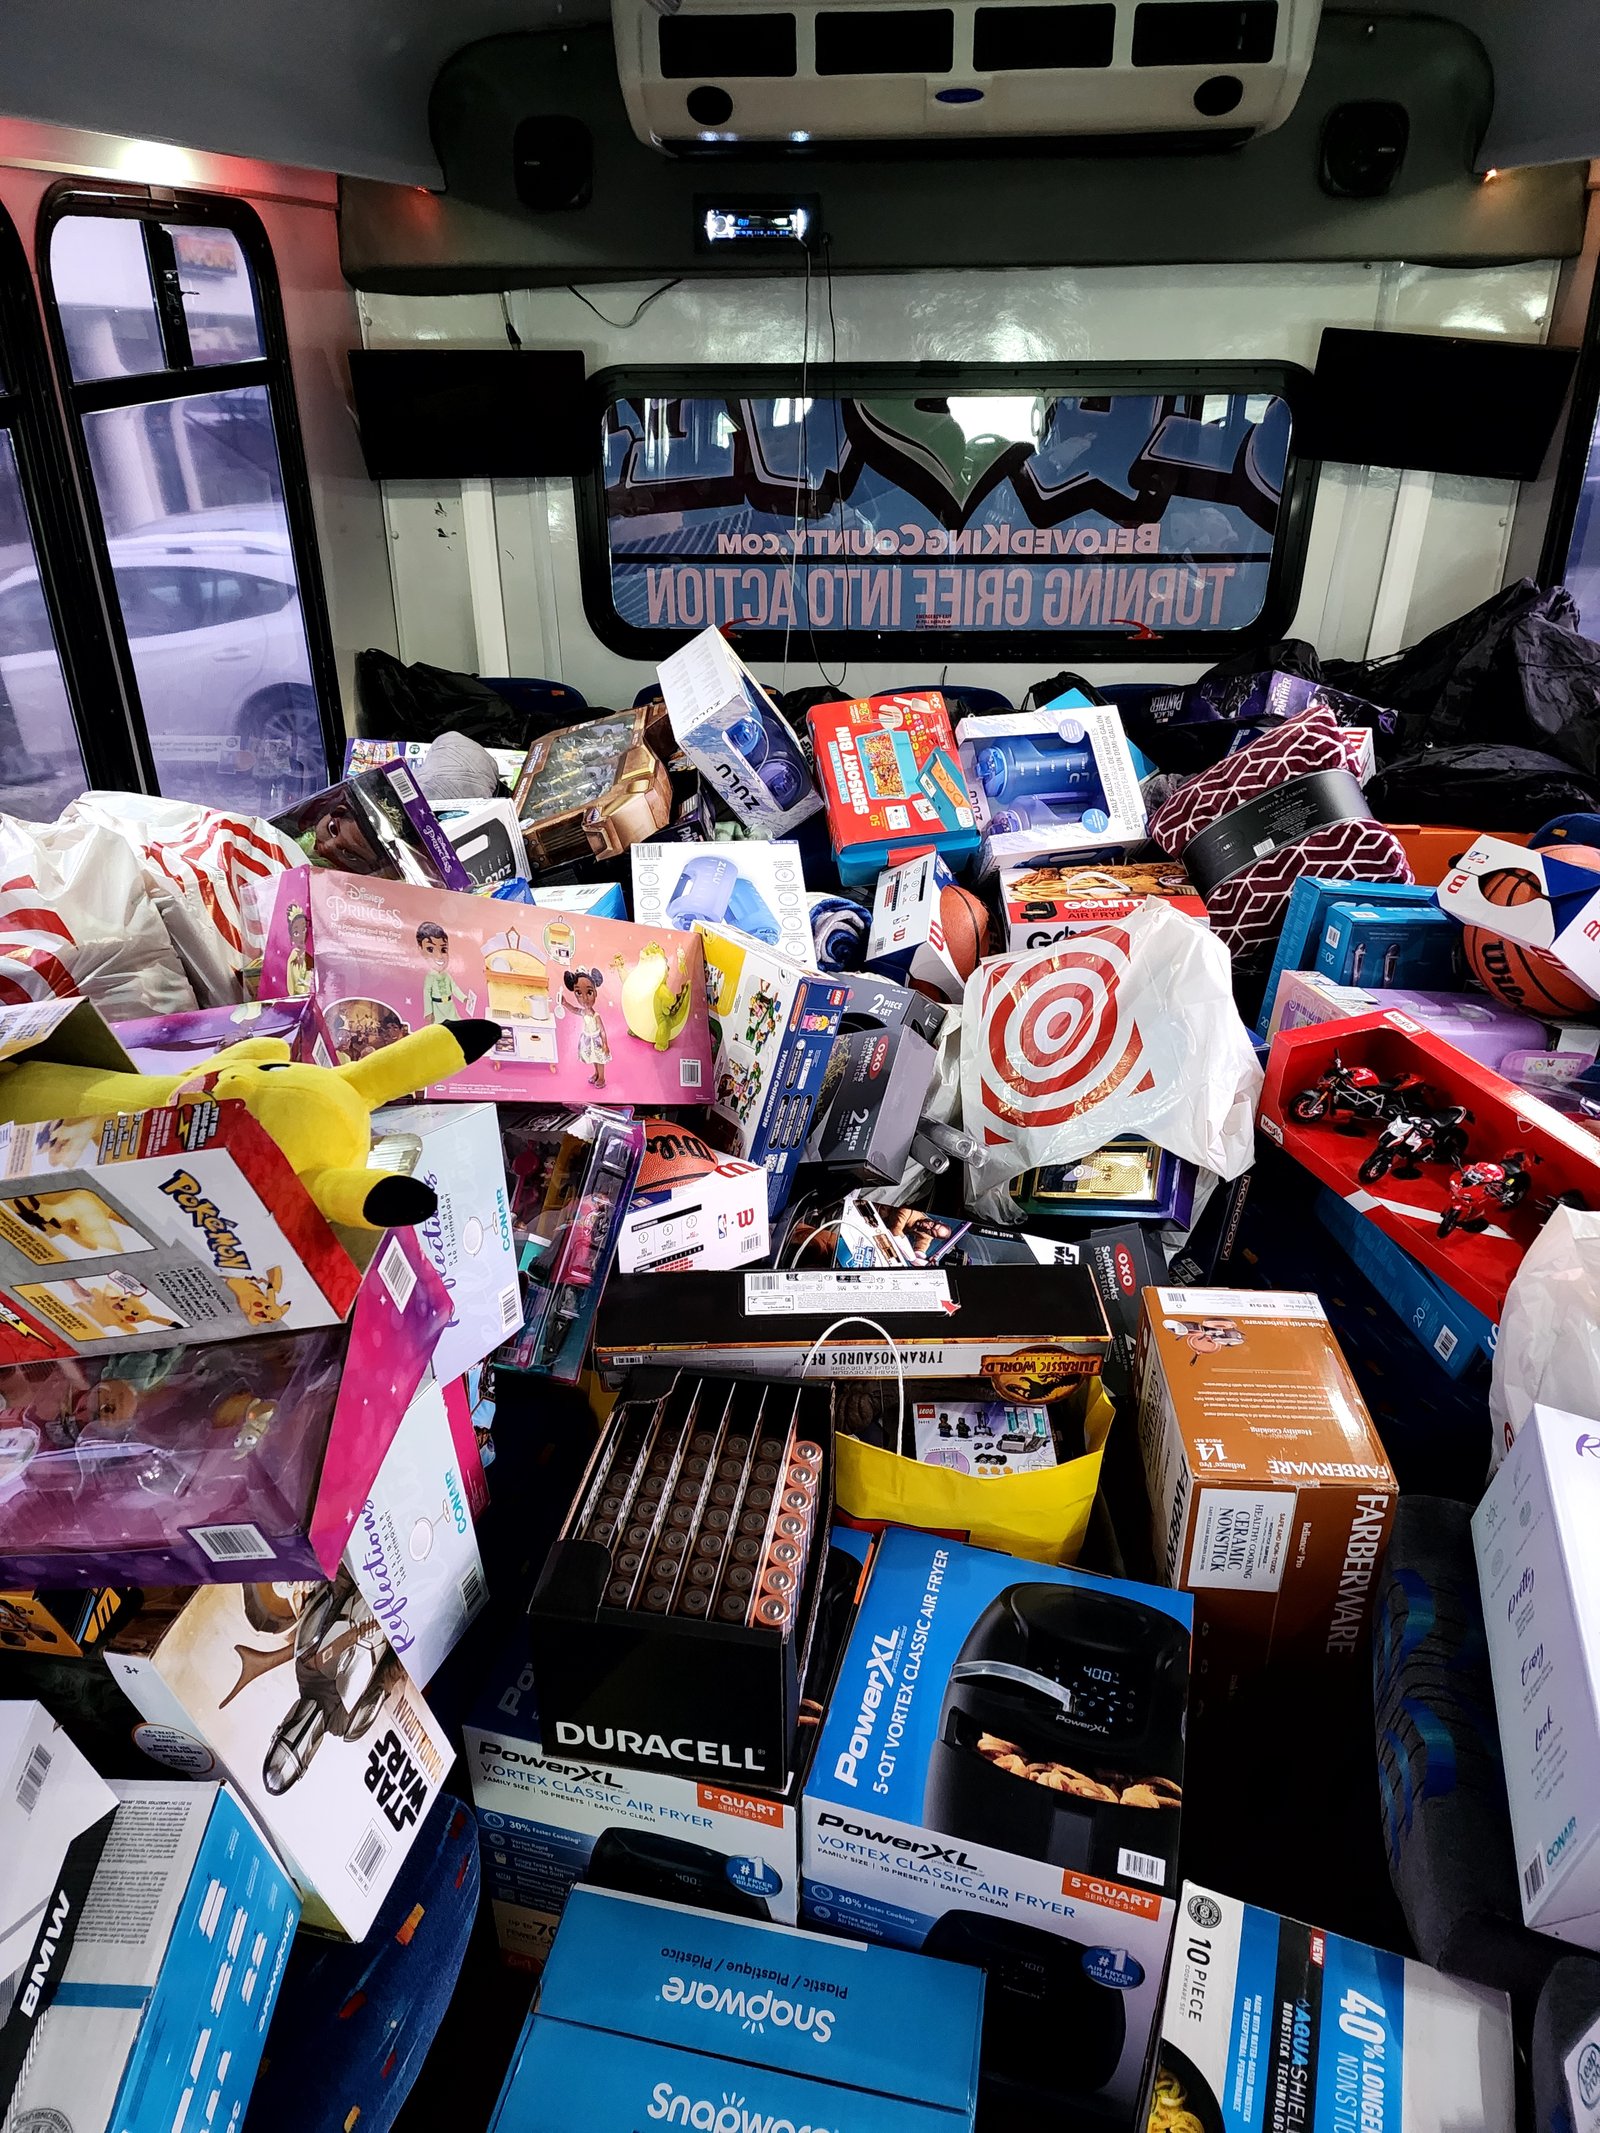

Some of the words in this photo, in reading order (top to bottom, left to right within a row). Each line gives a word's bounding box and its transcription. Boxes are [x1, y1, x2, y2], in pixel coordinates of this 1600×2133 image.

[1274, 677, 1292, 716] PANTHER
[835, 726, 854, 751] BIN
[1102, 736, 1113, 756] MEDIO
[1104, 715, 1120, 756] DEMI-GALLON
[713, 763, 761, 811] ZULU
[843, 753, 870, 815] SENSORY
[1103, 774, 1115, 797] GALLON
[870, 814, 881, 827] 50
[969, 790, 983, 822] ZULU
[1109, 798, 1120, 814] HALF
[423, 825, 453, 874] PRINCESS
[712, 860, 727, 886] ZULU
[326, 896, 402, 929] PRINCESS
[1063, 899, 1149, 910] Gourm
[1067, 911, 1089, 919] AIR
[868, 993, 885, 1014] 2
[883, 999, 903, 1010] PIECE
[880, 1008, 893, 1017] SET
[858, 1036, 877, 1083] SoftWorks
[871, 1042, 886, 1072] OXO
[762, 1082, 782, 1129] RECORRIDO
[777, 1049, 789, 1081] INICIAL
[849, 1108, 870, 1124] 2
[843, 1126, 855, 1142] SET
[848, 1126, 862, 1151] PIECE
[496, 1187, 511, 1252] CONAIR
[979, 1229, 999, 1237] WINDU
[1221, 1178, 1251, 1257] MONOPOLY
[1093, 1246, 1111, 1301] NON-STICK
[1101, 1245, 1120, 1300] SoftWorks
[1117, 1251, 1134, 1288] OXO
[211, 1287, 233, 1314] SOUNDS
[1410, 1304, 1429, 1328] 20
[831, 1350, 944, 1366] TYRANNOSAURUS
[984, 1359, 1037, 1373] WORLD
[1038, 1360, 1098, 1374] JURASSIC
[918, 1407, 934, 1416] LEGO
[1250, 1426, 1281, 1435] Cooking
[1282, 1428, 1313, 1436] Healthy
[1195, 1443, 1228, 1461] 14
[1269, 1460, 1390, 1480] FARBERWARE
[444, 1467, 467, 1534] CONAIR
[1250, 1504, 1264, 1542] HEALTHY
[1275, 1529, 1283, 1541] AND
[1277, 1512, 1286, 1528] SAFE
[1209, 1507, 1235, 1572] NONSTICK
[1227, 1510, 1251, 1571] CERAMIC
[928, 1549, 950, 1592] FRYER
[1243, 1543, 1257, 1579] COOKING
[1269, 1542, 1281, 1574] NON-TOXIC
[1295, 1556, 1306, 1569] Pro
[1325, 1493, 1390, 1655] FARBERWARE
[361, 1499, 416, 1655] Reflections
[920, 1591, 939, 1620] AIR
[903, 1619, 932, 1681] CLASSIC
[123, 1664, 139, 1675] 3+
[1082, 1665, 1112, 1683] 400
[833, 1628, 899, 1788] PowerXL
[884, 1682, 915, 1749] VORTEX
[392, 1695, 445, 1784] MANDALORIAN
[1055, 1714, 1110, 1735] PowerXL
[555, 1721, 766, 1773] DURACELL
[373, 1728, 428, 1817] WARS
[477, 1740, 624, 1789] PowerXL
[873, 1750, 898, 1796] 5-QT
[364, 1748, 417, 1832] STAR
[480, 1761, 547, 1787] VORTEX
[552, 1779, 622, 1807] CLASSIC
[626, 1798, 655, 1815] AIR
[659, 1806, 715, 1830] FRYER
[482, 1775, 511, 1789] FAMILY
[512, 1783, 531, 1793] SIZE
[540, 1788, 549, 1797] 10
[551, 1791, 585, 1806] PRESETS
[593, 1802, 614, 1813] EASY
[615, 1808, 627, 1817] TO
[628, 1811, 656, 1824] CLEAN
[703, 1789, 777, 1817] 5-QUART
[717, 1803, 750, 1818] SERVES
[752, 1811, 763, 1820] 5+
[508, 1819, 532, 1833] 30%
[533, 1826, 552, 1837] Faster
[817, 1812, 978, 1871] PowerXL
[1546, 1816, 1578, 1867] CONAIR
[732, 1873, 746, 1882] AIR
[747, 1878, 773, 1890] FRYER
[740, 1856, 765, 1881] #1
[817, 1833, 891, 1863] VORTEX
[896, 1857, 973, 1888] CLASSIC
[978, 1881, 1009, 1899] AIR
[1014, 1891, 1076, 1918] FRYER
[817, 1847, 847, 1860] FAMILY
[850, 1856, 869, 1867] SIZE
[879, 1865, 890, 1873] 10
[892, 1868, 929, 1884] PRESETS
[940, 1883, 961, 1895] EASY
[963, 1889, 977, 1899] TO
[979, 1894, 1009, 1908] CLEAN
[735, 1880, 770, 1893] BRANDS
[1069, 1876, 1155, 1910] 5-QUART
[1084, 1891, 1123, 1909] SERVES
[1123, 1902, 1137, 1912] 5+
[836, 1911, 855, 1921] Vortex
[857, 1917, 879, 1929] Rapid
[837, 1893, 863, 1909] 30%
[864, 1903, 885, 1915] Faster
[849, 1920, 884, 1937] Technology
[19, 1890, 72, 2019] BMW
[660, 1946, 713, 1971] Plástico
[1097, 1948, 1128, 1973] #1
[1185, 1936, 1212, 1966] 10
[1312, 1936, 1324, 1966] NEW
[258, 1907, 295, 2034] Snapware
[726, 1962, 790, 1987] Plastique
[1086, 1963, 1106, 1976] AIR
[1106, 1967, 1134, 1983] FRYER
[1089, 1969, 1130, 1987] BRANDS
[1182, 1964, 1191, 2003] COOKWARE
[802, 1978, 849, 2000] Plastic
[1188, 1968, 1208, 2023] PIECE
[660, 1976, 837, 2044] Snapware
[1178, 2002, 1186, 2017] SET
[1338, 1988, 1386, 2060] 40%
[1279, 2001, 1294, 2058] NONSTICK
[1580, 2049, 1598, 2086] Leap
[1585, 2062, 1600, 2101] Fro
[1232, 2058, 1247, 2112] PERFORMANCE
[1333, 2050, 1360, 2133] NONSTIC
[646, 2082, 834, 2133] Snapwar
[1242, 2085, 1254, 2123] NONSTICK
